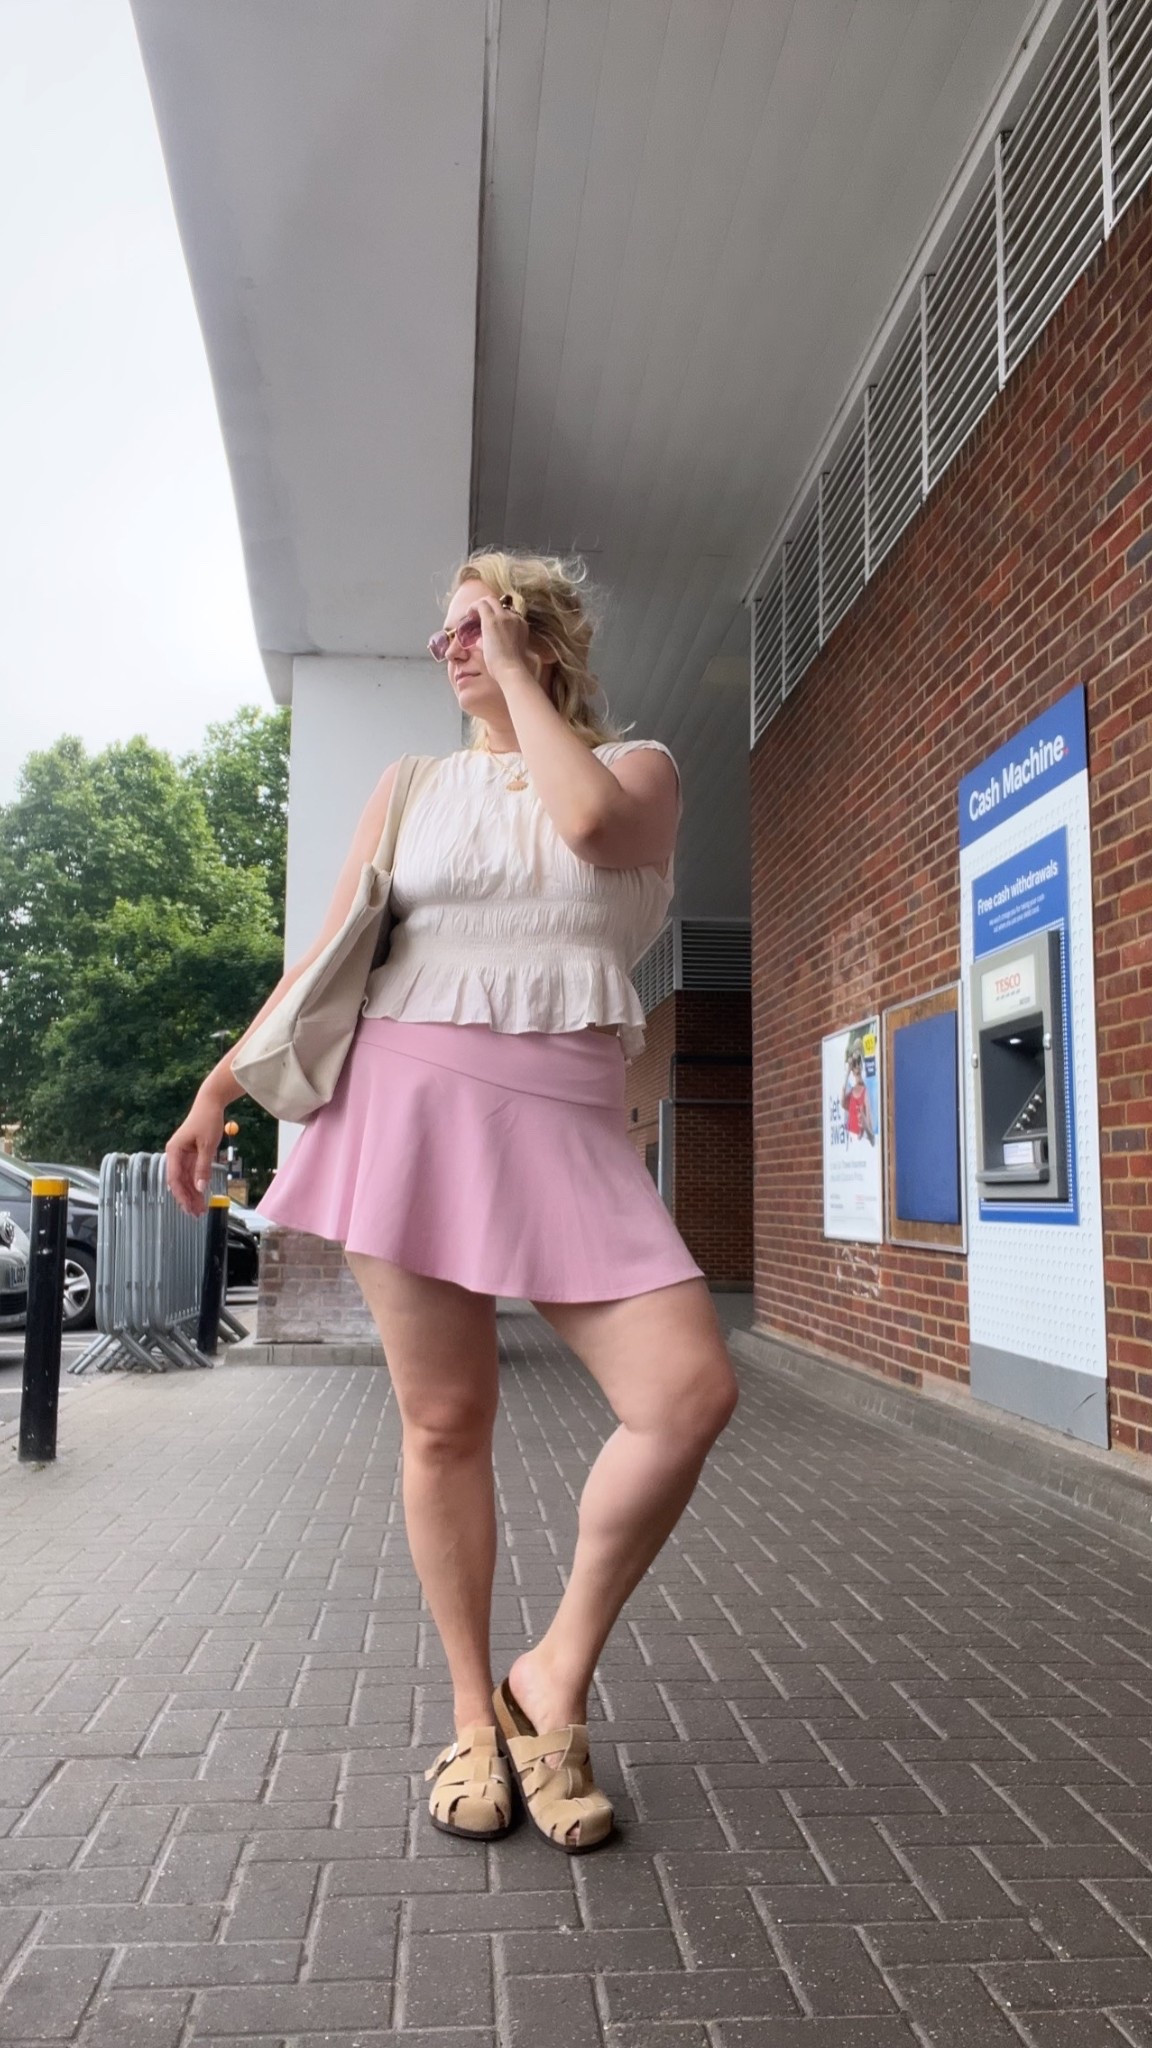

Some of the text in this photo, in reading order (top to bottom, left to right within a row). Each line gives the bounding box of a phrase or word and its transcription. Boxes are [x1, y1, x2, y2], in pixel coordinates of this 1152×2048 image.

[969, 735, 1069, 821] Cash Machine.
[978, 898, 992, 916] Free
[993, 885, 1010, 907] cash
[1010, 859, 1058, 898] withdrawals
[995, 972, 1021, 994] TESCO
